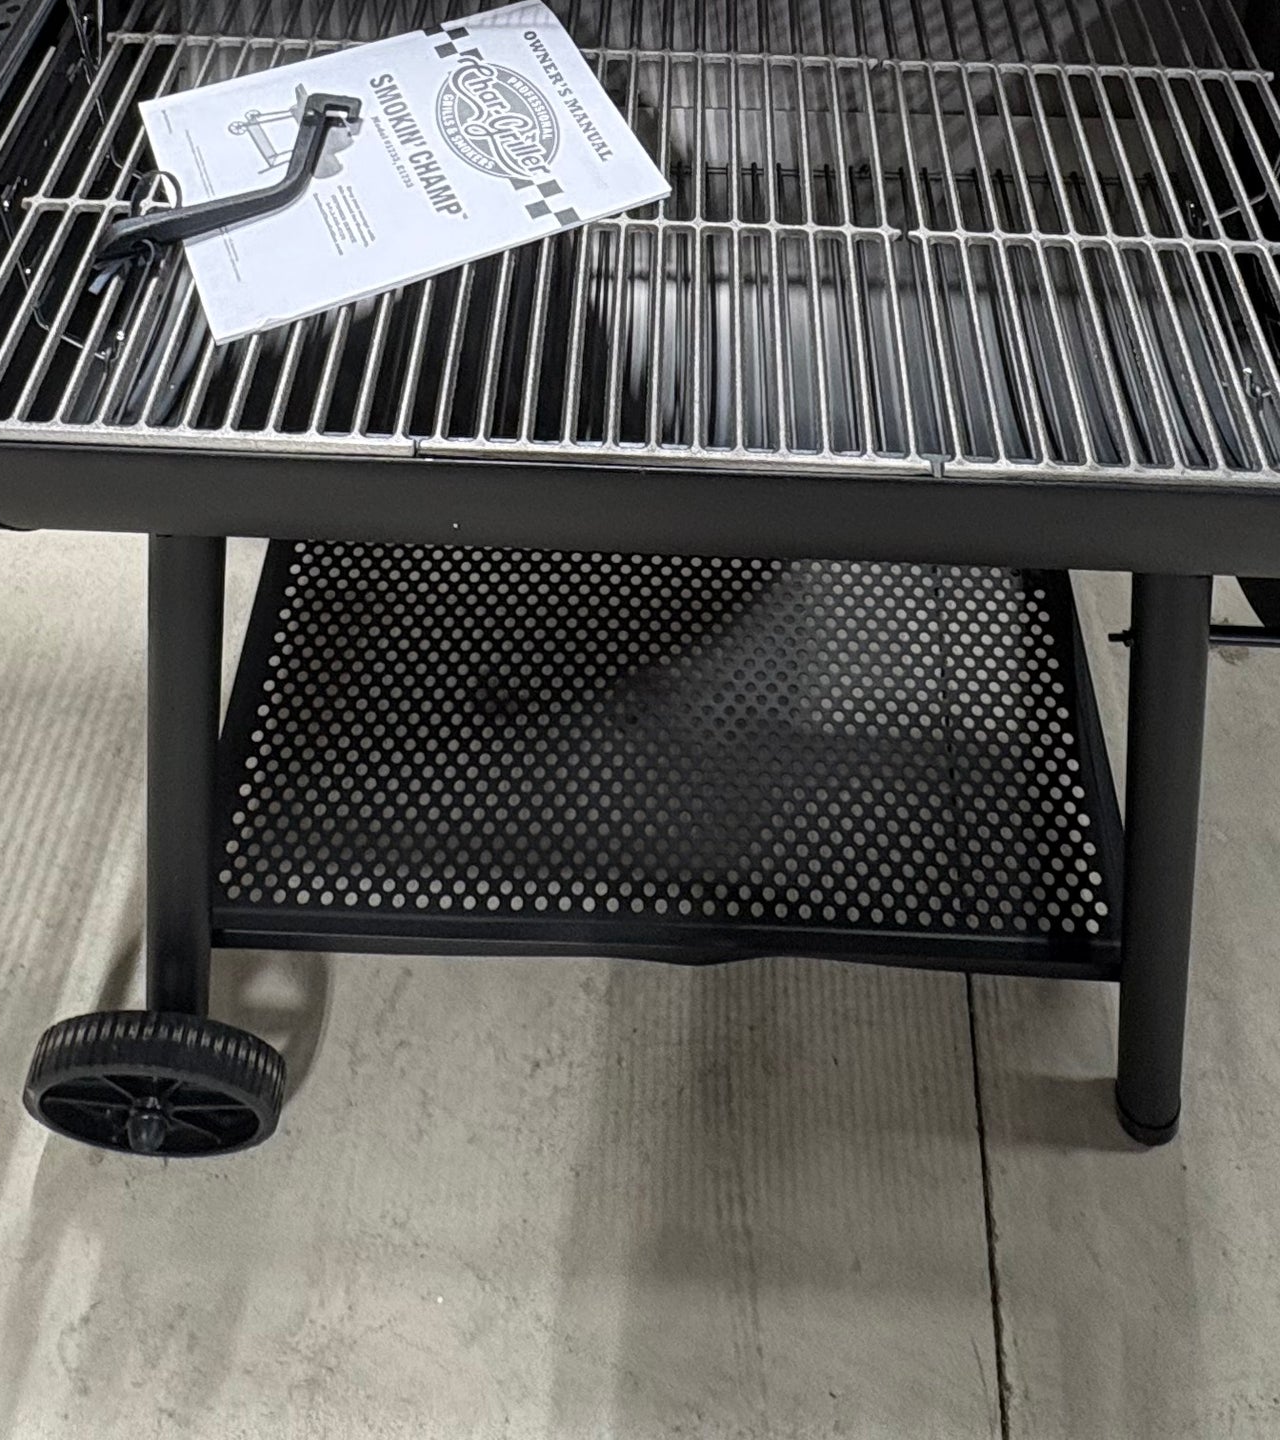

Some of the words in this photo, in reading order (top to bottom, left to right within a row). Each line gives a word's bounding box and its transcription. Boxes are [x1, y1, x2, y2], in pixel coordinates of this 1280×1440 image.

[370, 73, 427, 147] SMOKIN'
[371, 115, 387, 142] Model
[441, 93, 457, 126] GRILLS
[451, 134, 496, 171] SMOKERS
[448, 56, 551, 178] Char-Griller
[507, 76, 554, 140] PROFESSIONAL
[523, 30, 573, 98] OWNER'S
[564, 97, 614, 162] MANUAL
